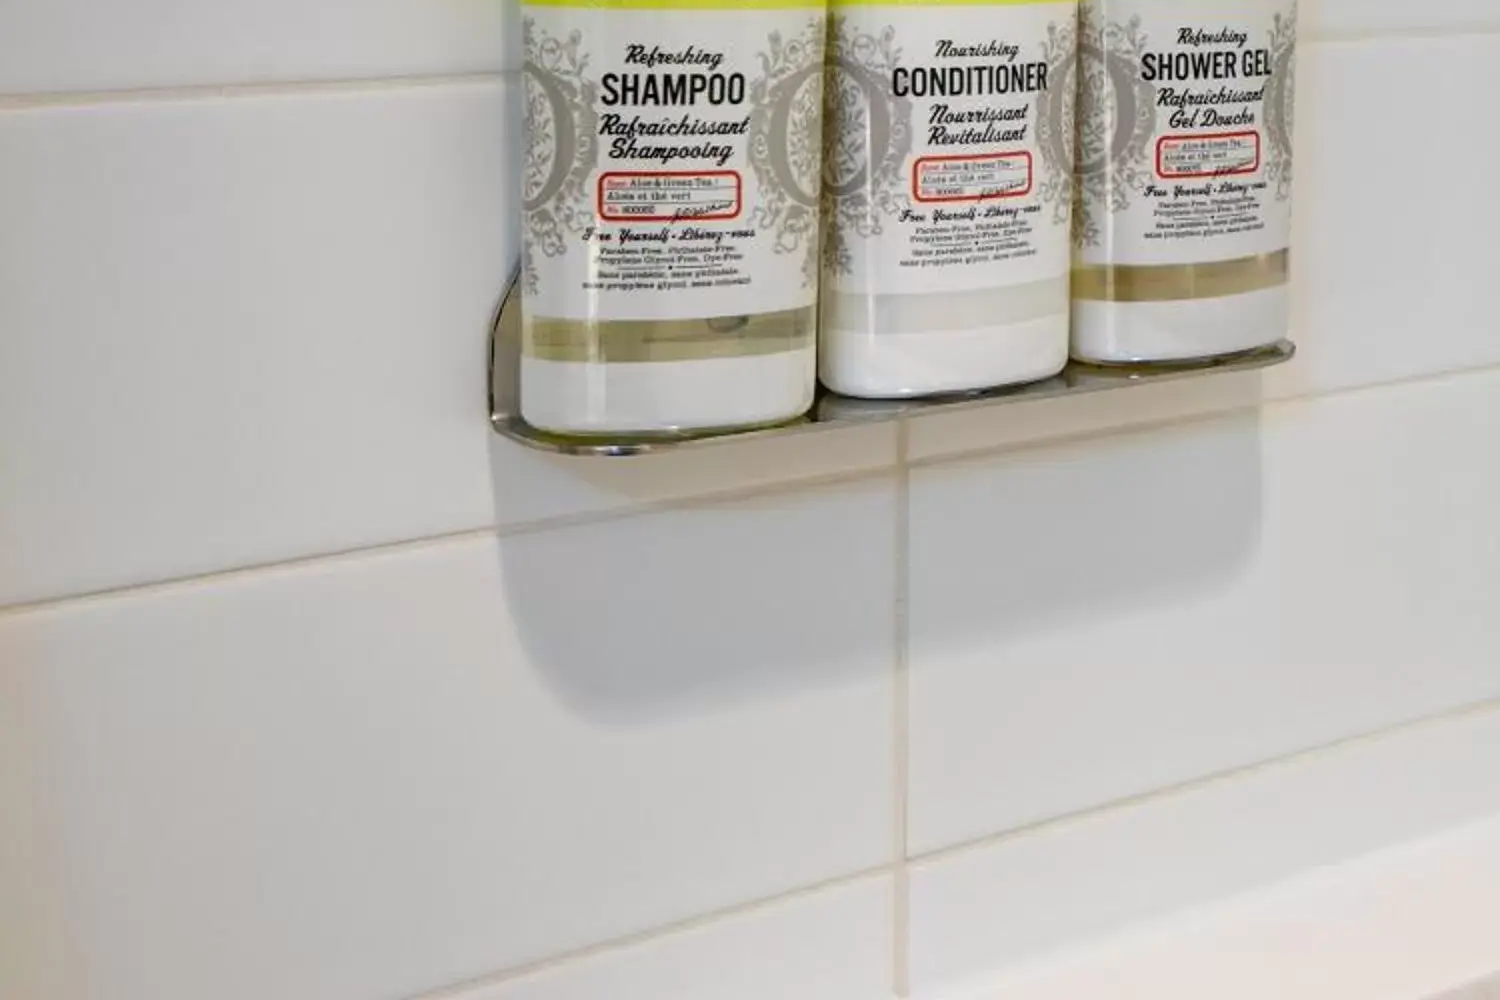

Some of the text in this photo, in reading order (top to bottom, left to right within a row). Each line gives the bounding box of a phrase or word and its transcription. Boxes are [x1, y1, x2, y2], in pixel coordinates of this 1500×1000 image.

[1176, 26, 1249, 48] Refreshing
[624, 43, 724, 71] Refreshing
[934, 39, 1019, 62] Nourishing
[1141, 49, 1272, 81] SHOWER GEL
[601, 72, 746, 106] SHAMPOO
[893, 62, 1048, 97] CONDITIONER
[599, 112, 751, 138] Rafraîchissant
[929, 103, 1029, 125] Nourrissant
[1169, 106, 1255, 128] Gel Douche
[927, 123, 1027, 146] Revitalisant
[608, 137, 734, 167] Shampooing
